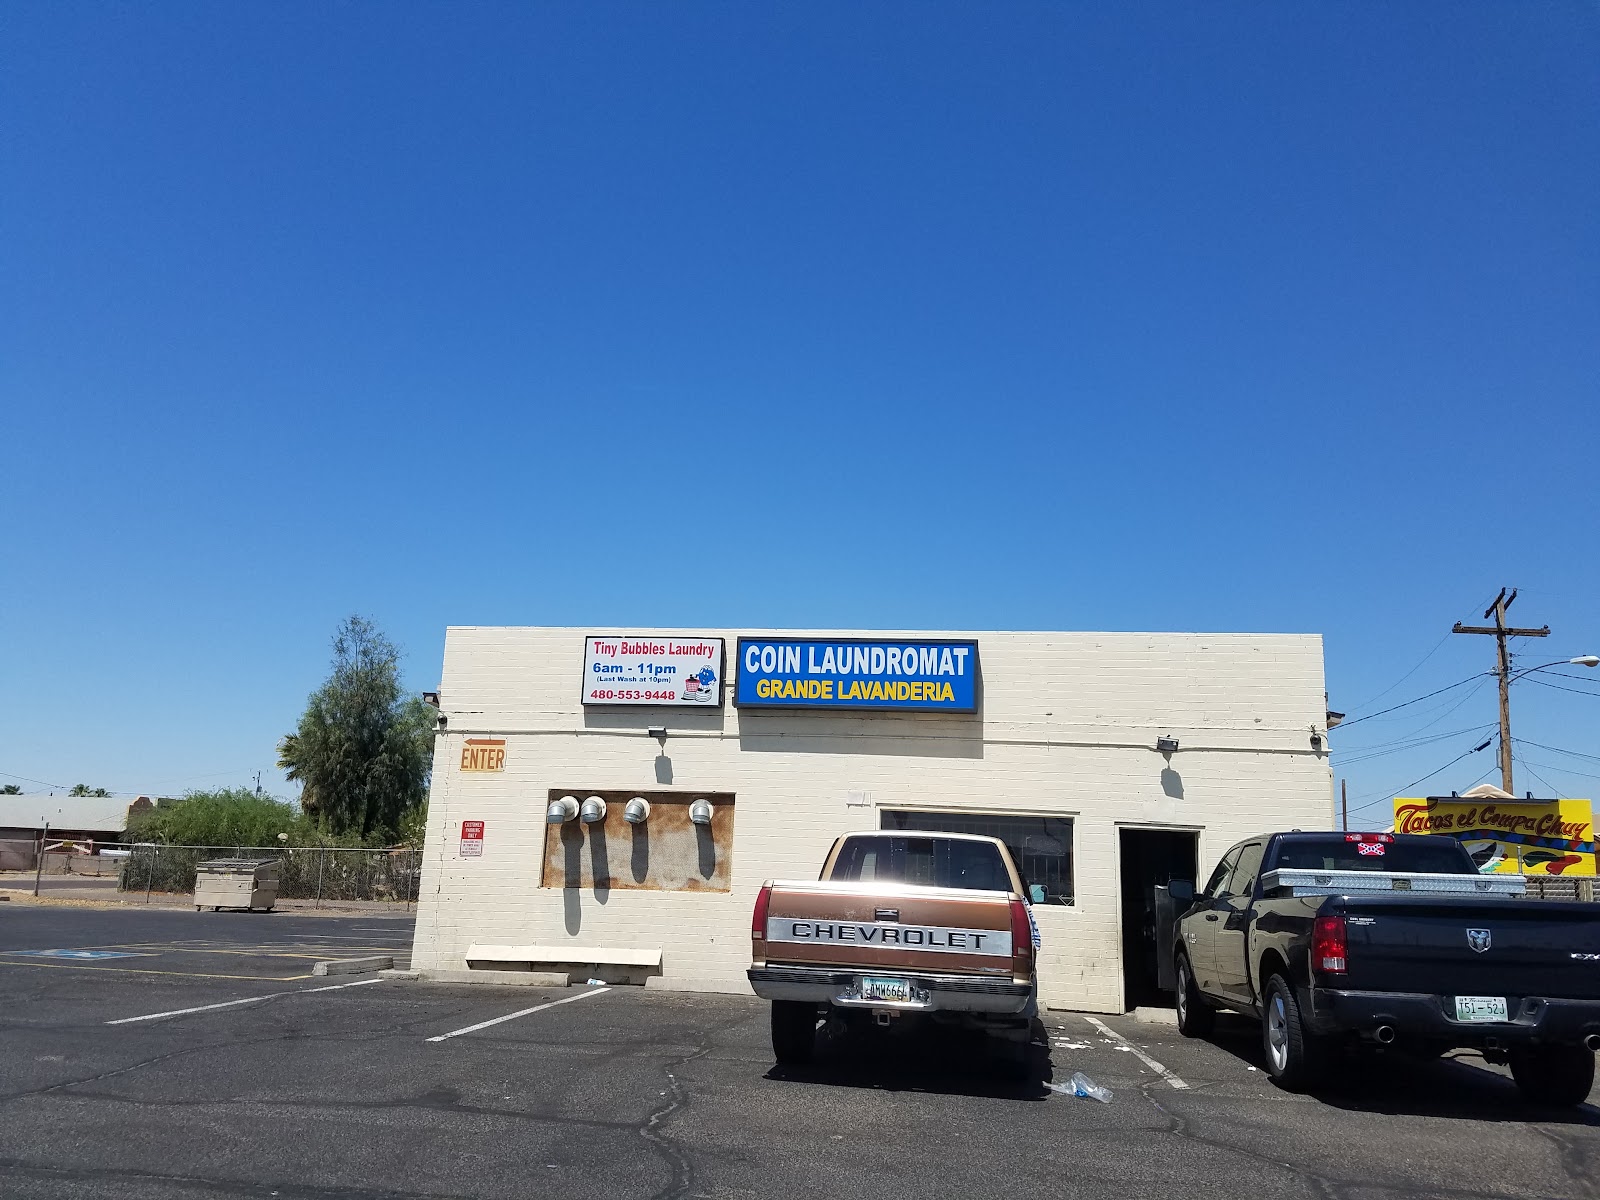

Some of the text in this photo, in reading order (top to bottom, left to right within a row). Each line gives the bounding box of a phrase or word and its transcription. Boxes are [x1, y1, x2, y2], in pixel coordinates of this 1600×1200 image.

[594, 641, 714, 658] Tiny Bubbles Laundry
[745, 645, 969, 676] COIN LAUNDROMAT
[593, 662, 623, 673] 6am
[637, 663, 676, 676] 11pm
[590, 689, 675, 701] 480-553-9448
[756, 679, 955, 702] GRANDE LAVANDERIA
[460, 748, 505, 770] ENTER
[1395, 800, 1590, 842] Tacos el Compa Chuy
[791, 922, 988, 951] CHEVROLET
